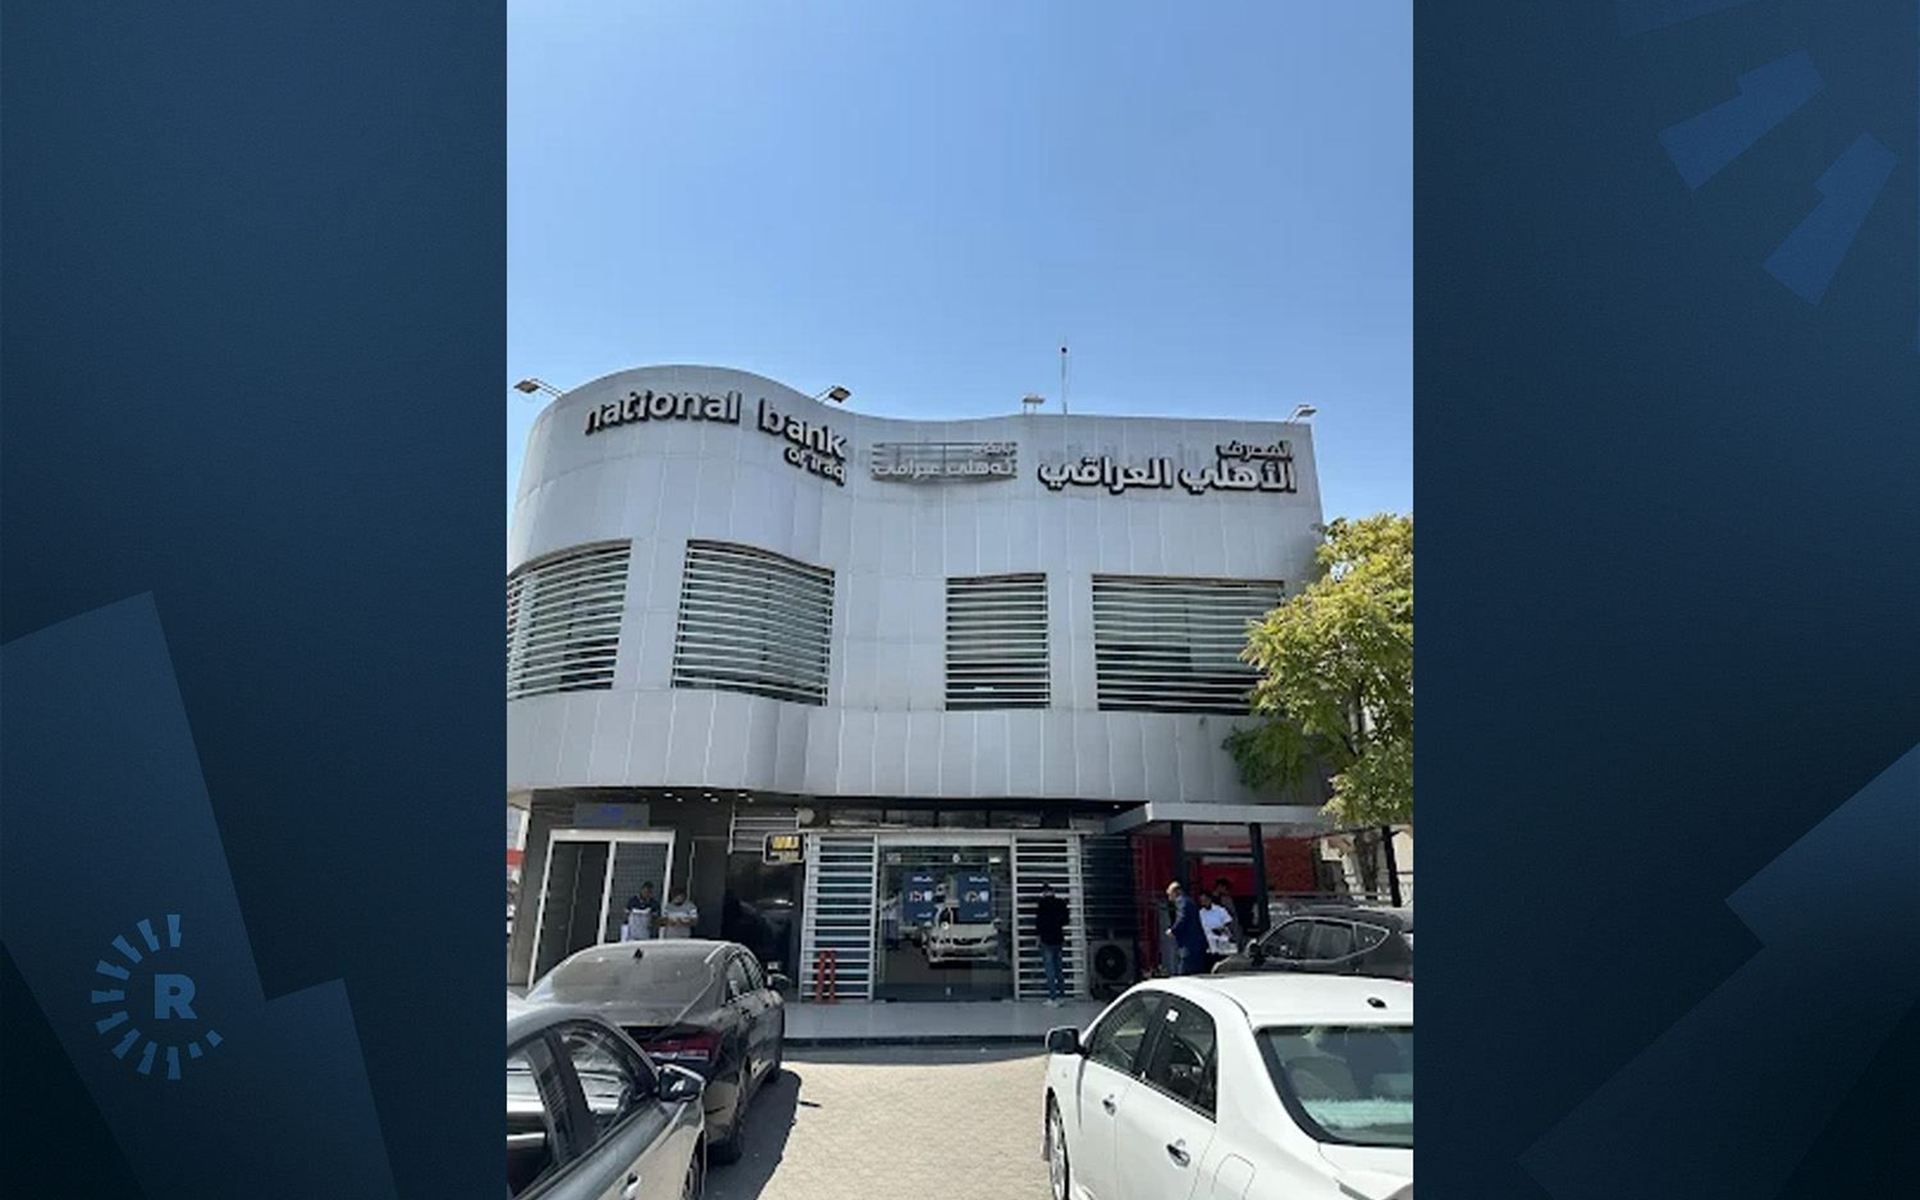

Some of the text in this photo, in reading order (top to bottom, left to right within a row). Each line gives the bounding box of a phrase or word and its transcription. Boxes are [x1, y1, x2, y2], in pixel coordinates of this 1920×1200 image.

[585, 390, 847, 458] national bank
[1037, 456, 1297, 495] الأهلي العراقي
